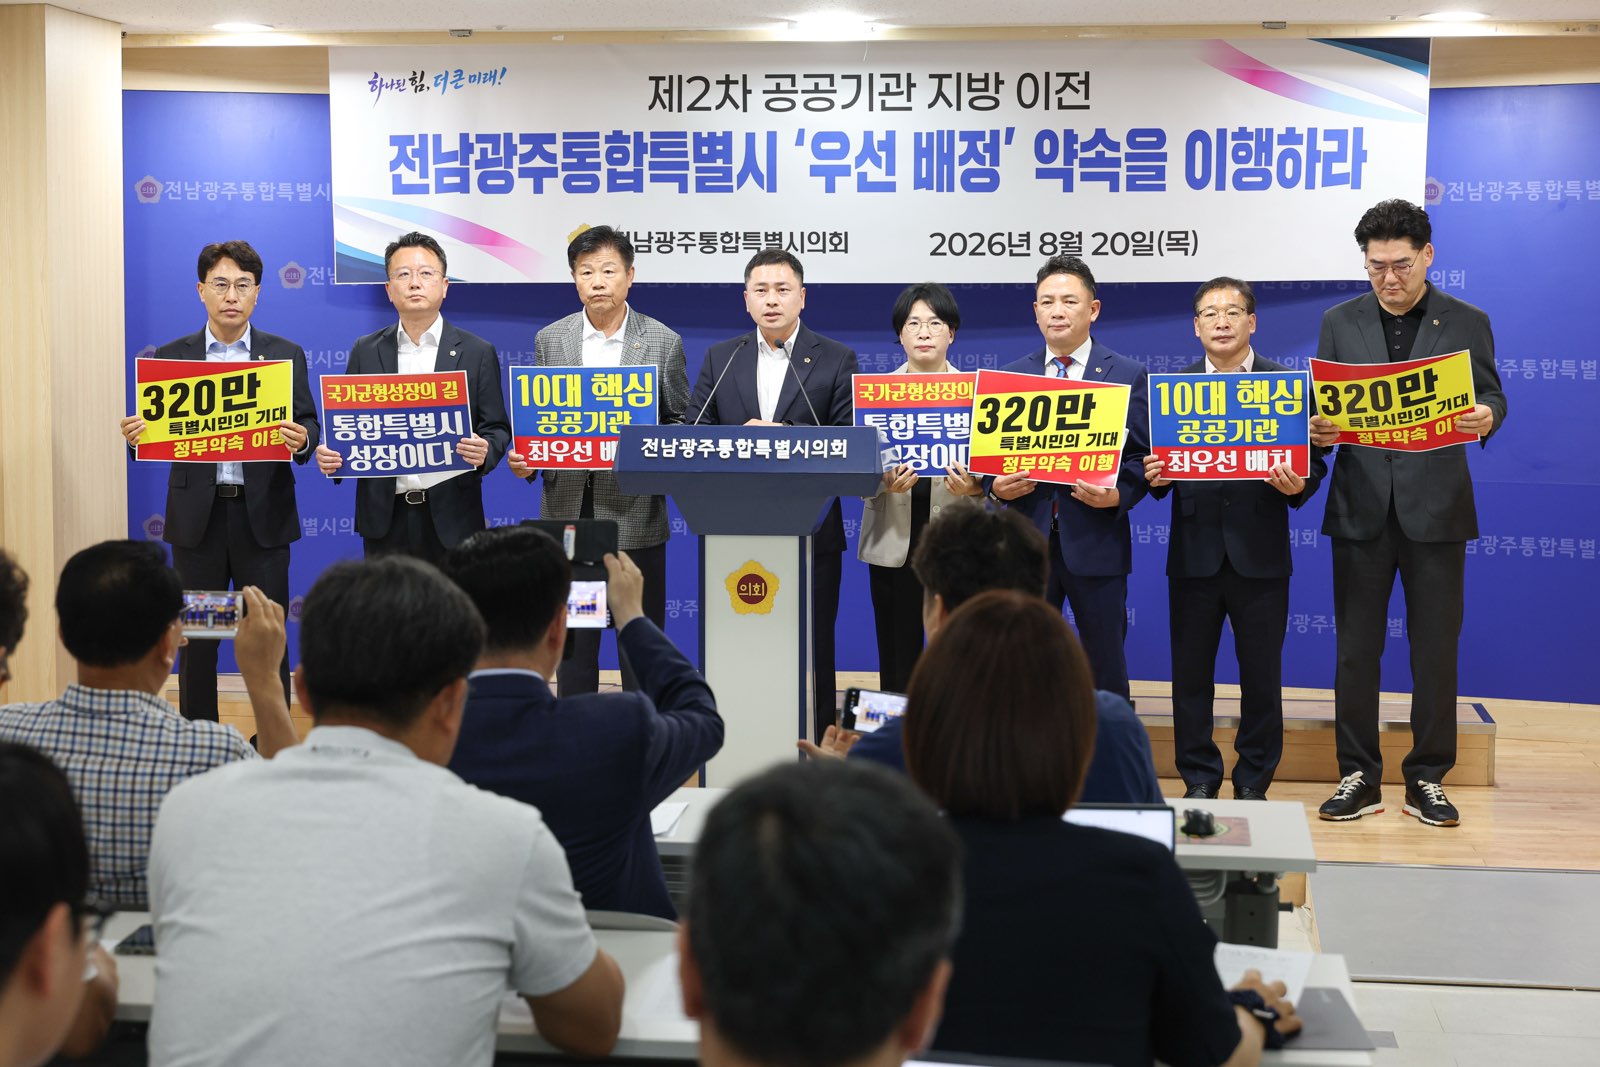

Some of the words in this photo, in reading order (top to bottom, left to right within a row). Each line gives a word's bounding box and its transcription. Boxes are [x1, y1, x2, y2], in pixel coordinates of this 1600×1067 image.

[368, 71, 406, 108] 하나된
[408, 70, 430, 94] 힘,
[468, 66, 507, 87] 미래!
[648, 73, 751, 113] 제2차
[762, 72, 916, 113] 공공기관
[926, 71, 1005, 110] 지방
[1016, 70, 1092, 110] 이전
[389, 129, 778, 195] 전남광주통합특별시
[1034, 126, 1168, 193] 약속을
[1184, 125, 1368, 191] 이행하라
[929, 231, 1032, 257] 2026년
[1038, 231, 1084, 257] 8월
[1091, 229, 1199, 257] 20일(목)
[1494, 359, 1600, 380] 주통합특별
[143, 372, 261, 421] 320만
[327, 382, 437, 403] 국가균형성장의
[441, 380, 459, 400] 길
[516, 374, 583, 408] 10대
[590, 372, 653, 408] 핵심
[858, 381, 974, 402] 국가균형성장의
[1155, 381, 1227, 416] 10대
[1236, 379, 1303, 416] 핵심
[1319, 367, 1438, 417] 320만
[168, 412, 249, 436] 특별시민의
[255, 406, 287, 424] 기대
[332, 410, 464, 441] 통합특별시
[536, 410, 632, 435] 공공기관
[977, 393, 1097, 435] 320만
[1348, 406, 1430, 429] 특별시민의
[1436, 393, 1470, 415] 기대
[1000, 433, 1080, 451] 특별시민의
[1085, 431, 1119, 448] 기대
[1176, 418, 1280, 444] 공공기관
[1356, 426, 1428, 445] 정부약속
[1435, 414, 1462, 436] 이
[173, 434, 244, 459] 정부약속
[346, 441, 454, 471] 성장이다
[527, 440, 593, 463] 최우선
[641, 437, 848, 459] 전남광주통합특별시의회
[1167, 449, 1238, 473] 최우선
[1245, 449, 1292, 472] 배치
[1002, 455, 1072, 474] 정부약속
[1078, 453, 1116, 472] 이행
[738, 582, 765, 597] 의회
